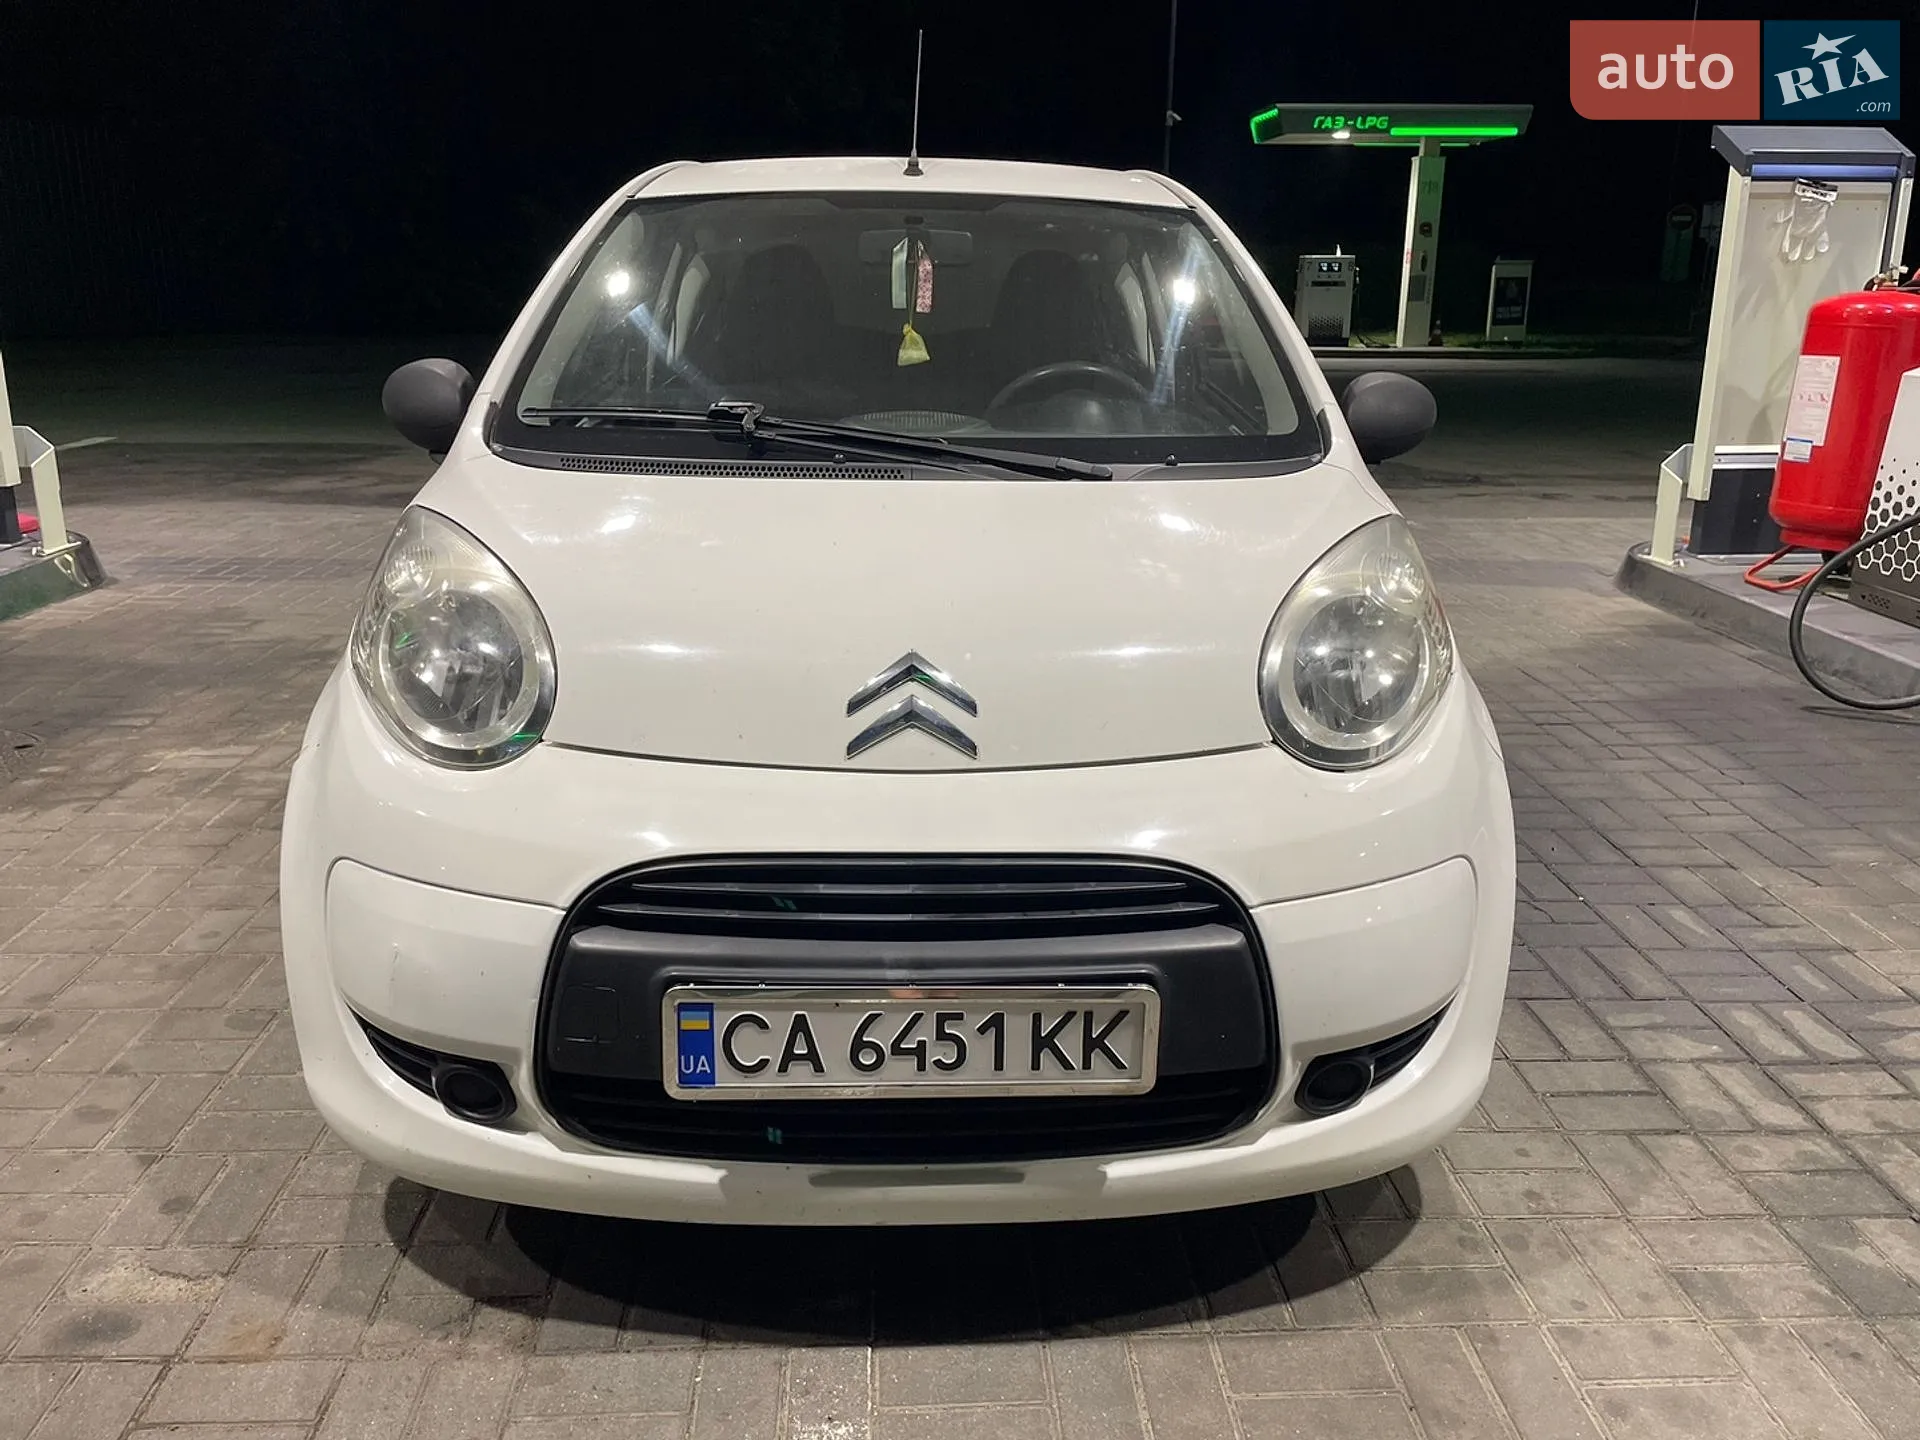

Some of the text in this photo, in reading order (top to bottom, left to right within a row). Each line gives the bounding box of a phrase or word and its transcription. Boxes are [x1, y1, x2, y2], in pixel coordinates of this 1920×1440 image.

[849, 1011, 1006, 1073] 6451
[1030, 1010, 1130, 1072] KK
[680, 1055, 711, 1075] UA
